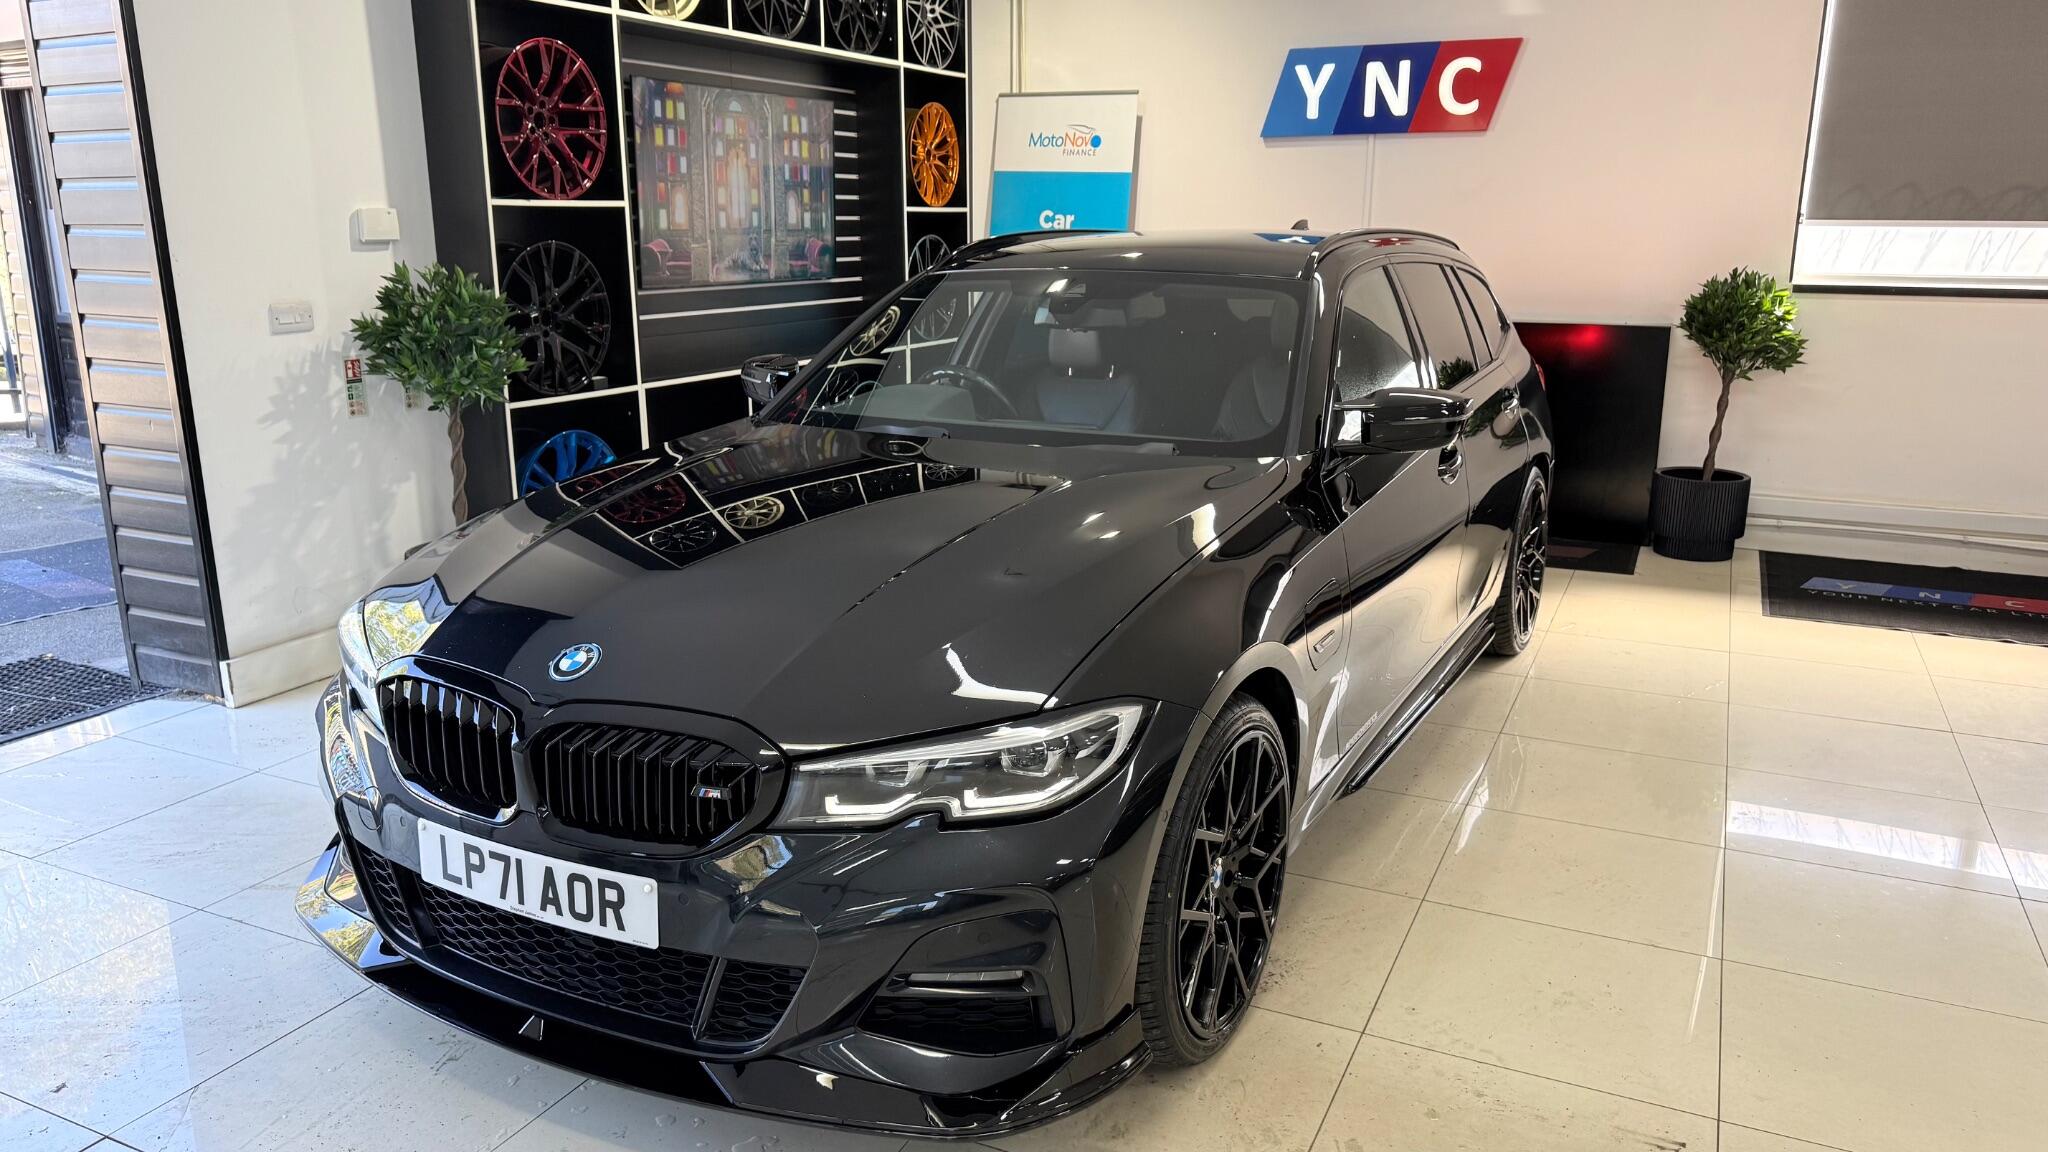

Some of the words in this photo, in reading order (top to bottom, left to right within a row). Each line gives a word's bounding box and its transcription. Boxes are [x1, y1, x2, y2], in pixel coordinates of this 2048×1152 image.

[1295, 56, 1482, 120] YNC
[1062, 148, 1097, 157] FINANCE
[1039, 209, 1075, 230] Car
[1807, 589, 1868, 600] YOUR
[1881, 596, 1939, 607] NEXT
[1951, 604, 1999, 614] CAR
[439, 833, 525, 906] LP71
[539, 865, 626, 932] AOR
